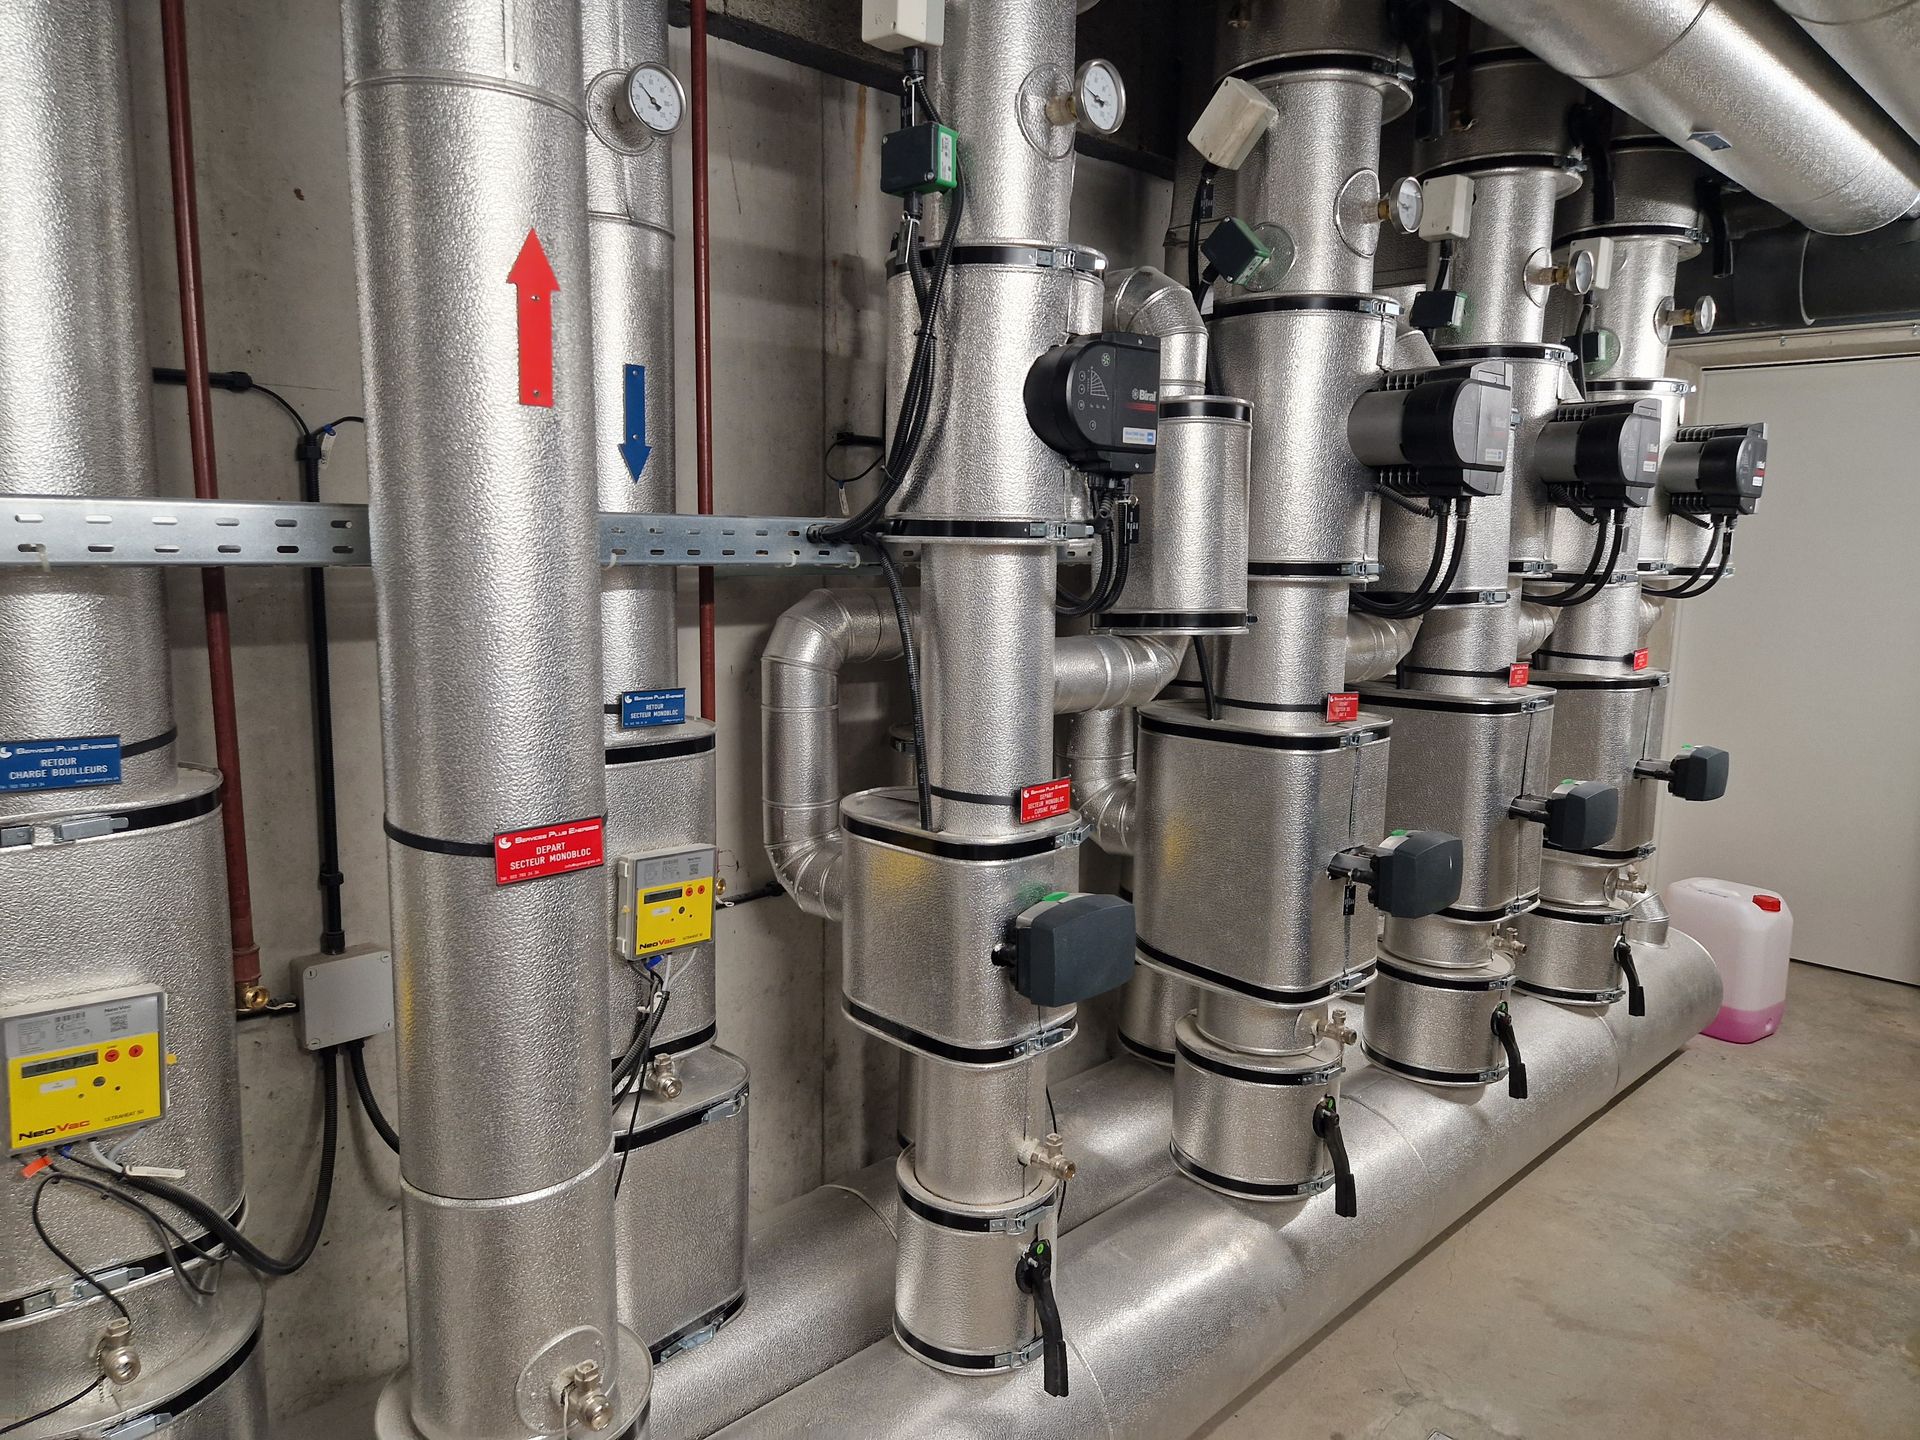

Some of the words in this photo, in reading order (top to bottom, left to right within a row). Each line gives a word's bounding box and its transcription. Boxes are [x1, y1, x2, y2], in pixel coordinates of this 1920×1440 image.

[1139, 389, 1156, 402] Biral
[41, 757, 77, 767] RETOUR
[9, 769, 48, 780] CHARGE
[52, 765, 108, 777] BOUILLEURS
[536, 842, 566, 855] DEPART
[510, 857, 545, 870] SECTEUR
[550, 848, 591, 862] MONOBLOC
[639, 938, 676, 950] NeoVac
[104, 1111, 136, 1122] ULTRAHEAT
[18, 1120, 90, 1141] NeoVac
